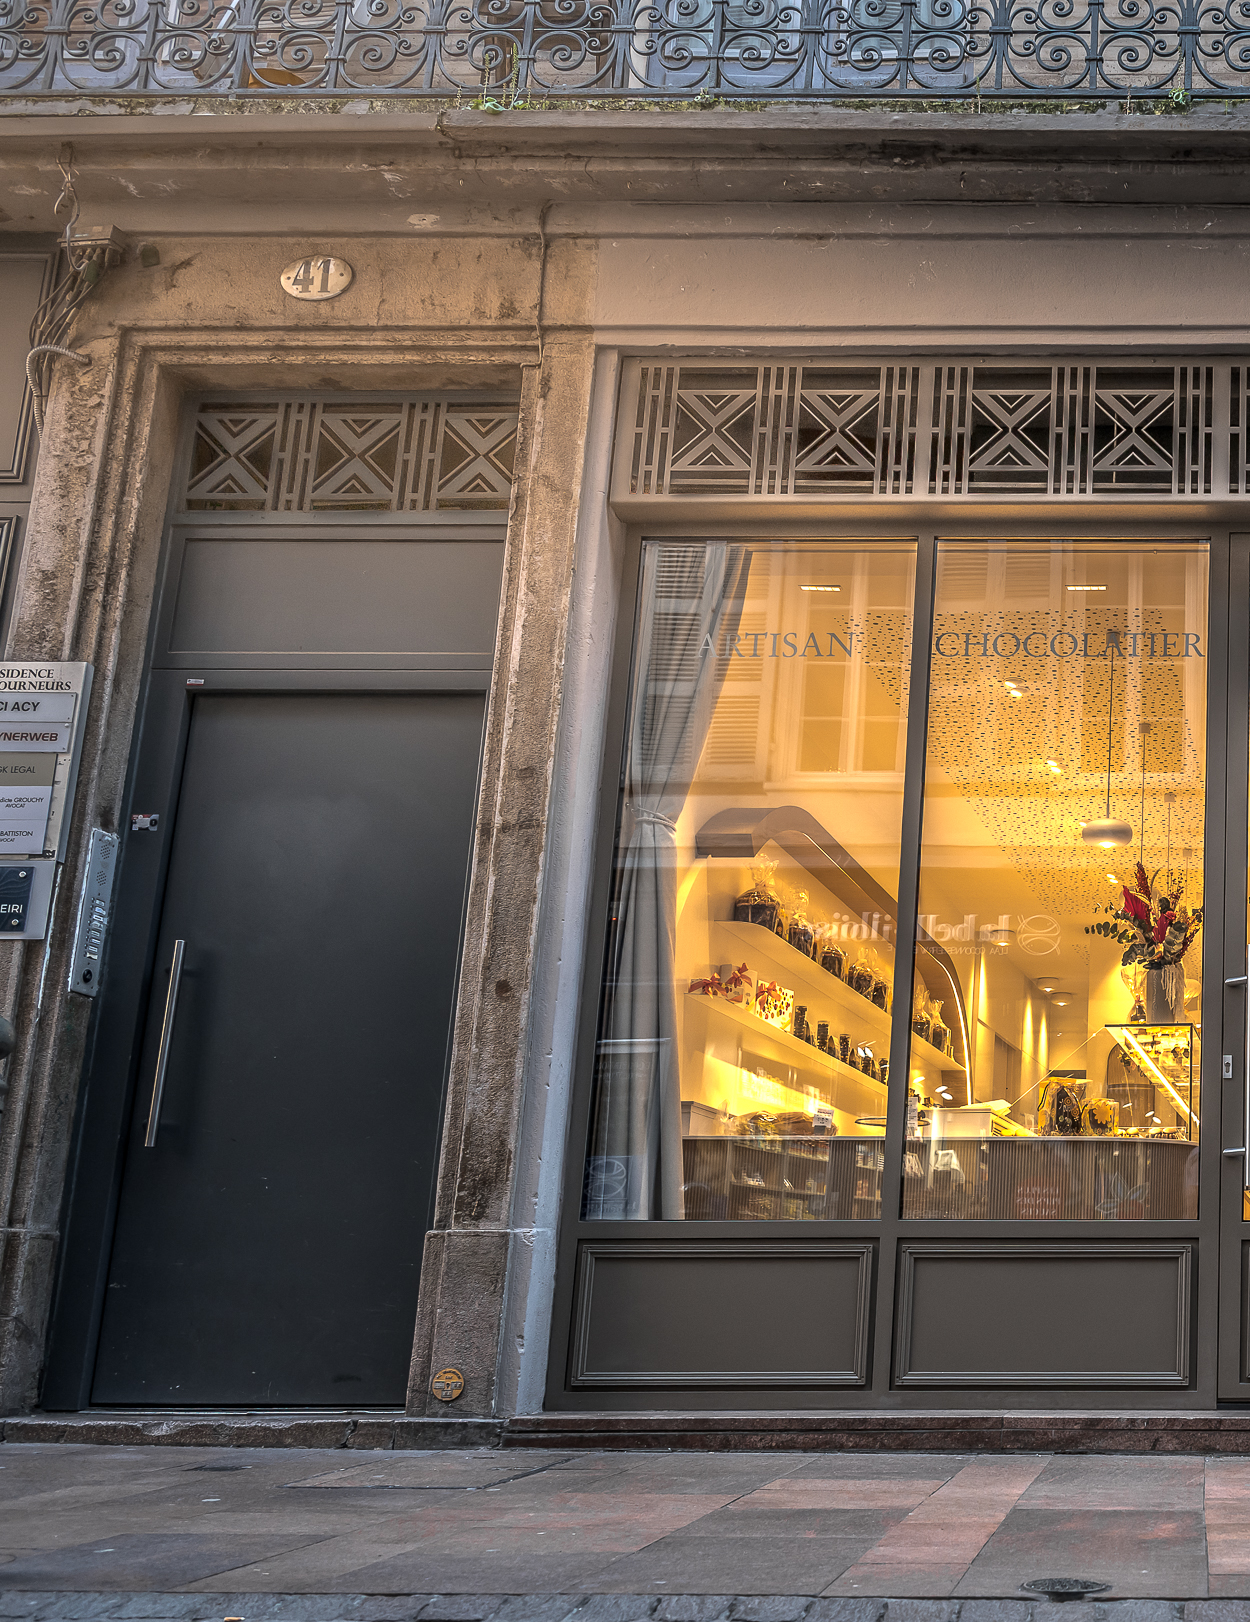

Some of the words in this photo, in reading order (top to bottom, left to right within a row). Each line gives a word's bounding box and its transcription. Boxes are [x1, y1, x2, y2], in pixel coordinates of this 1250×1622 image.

[292, 259, 331, 293] 41
[695, 631, 857, 659] ARTISAN
[935, 631, 1204, 659] CHOCOLATIER
[11, 701, 40, 711] ACY
